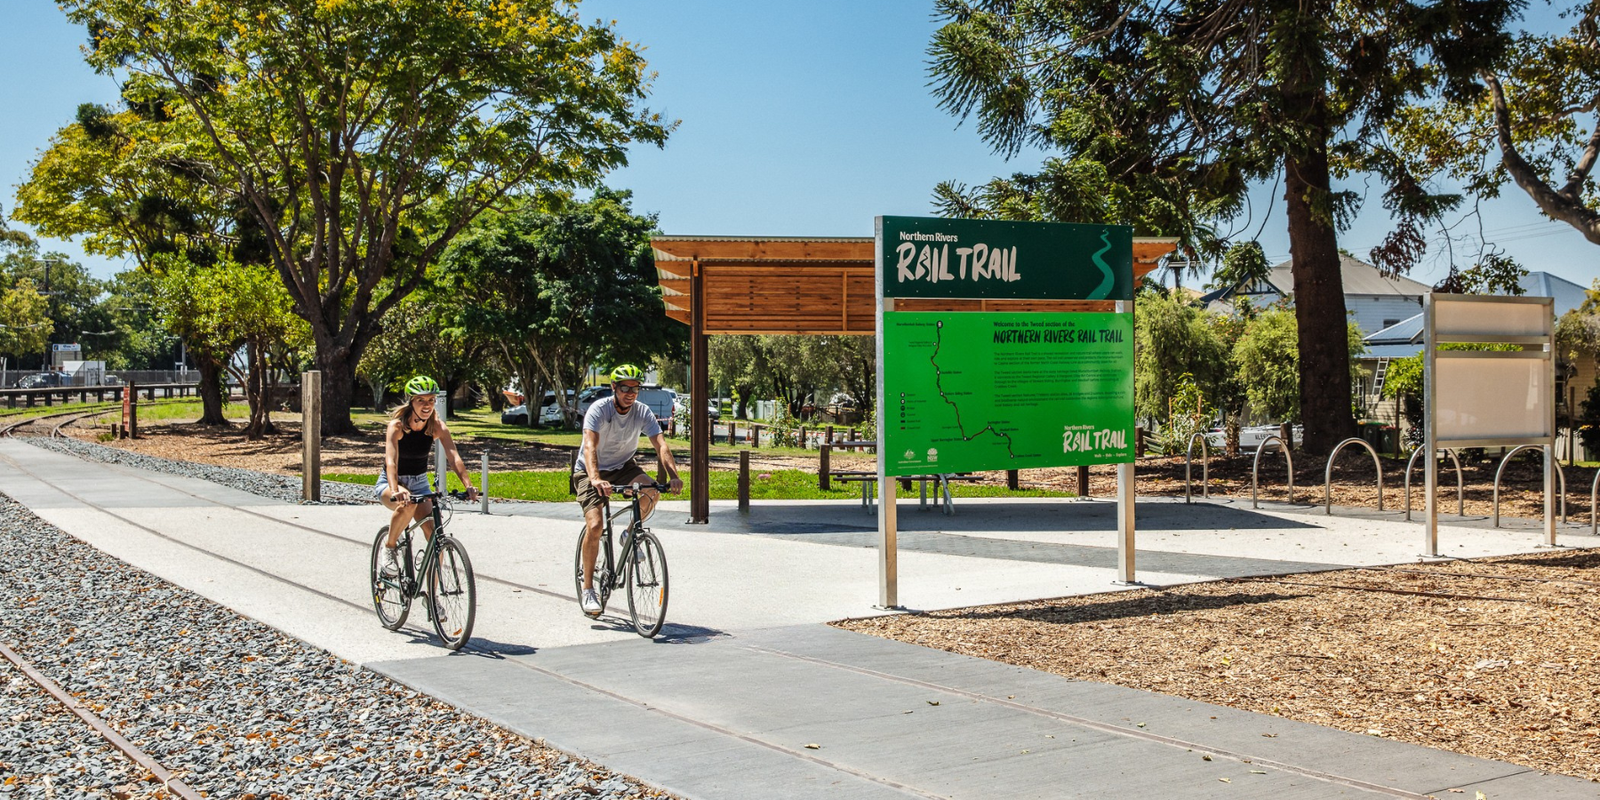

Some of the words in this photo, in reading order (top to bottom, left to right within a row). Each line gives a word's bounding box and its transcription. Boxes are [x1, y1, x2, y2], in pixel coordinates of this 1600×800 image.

[900, 231, 934, 242] Northern
[935, 232, 958, 242] Rivers
[896, 242, 955, 283] RAIL
[956, 243, 1021, 282] TRAIL
[993, 329, 1041, 344] NORTHERN
[1043, 329, 1075, 343] RIVERS
[1077, 329, 1097, 343] RAIL
[1099, 329, 1123, 343] TRAIL
[1062, 430, 1093, 453] RAIL
[1093, 428, 1127, 450] TRAIL
